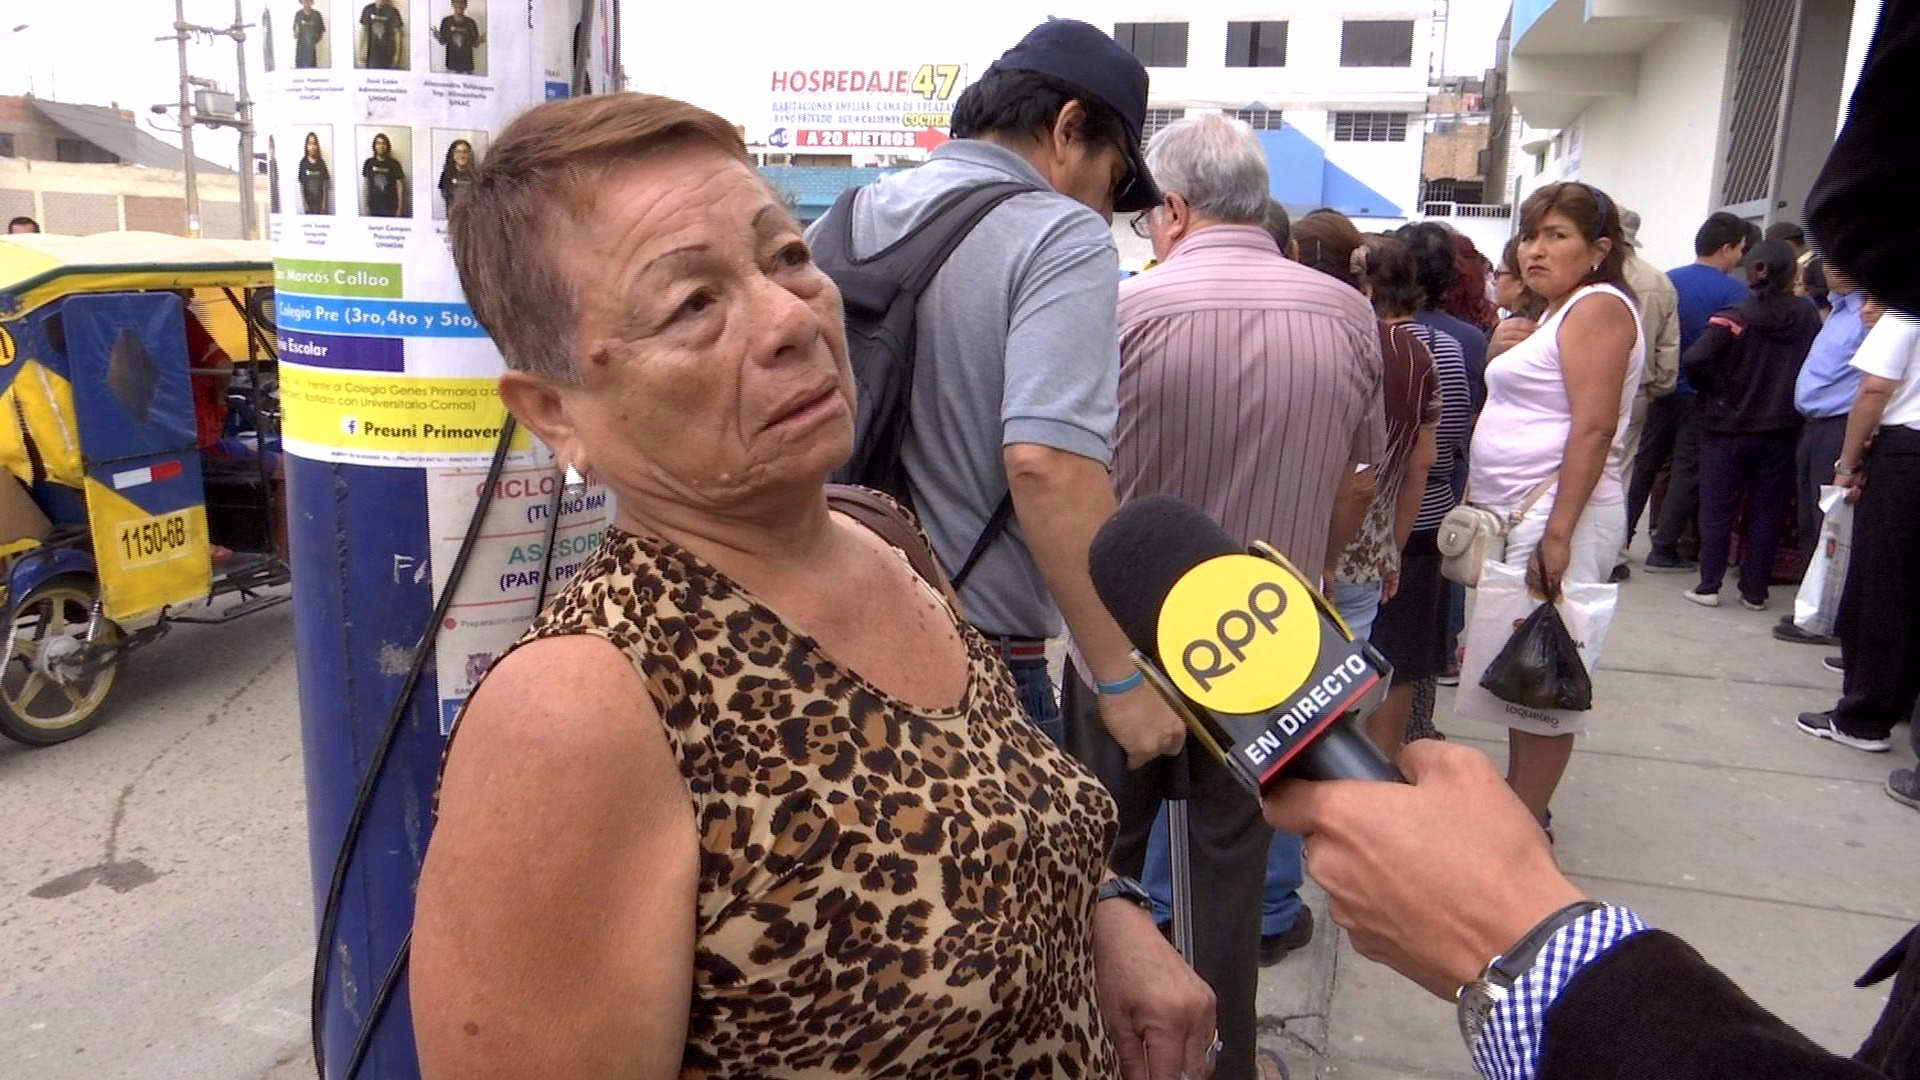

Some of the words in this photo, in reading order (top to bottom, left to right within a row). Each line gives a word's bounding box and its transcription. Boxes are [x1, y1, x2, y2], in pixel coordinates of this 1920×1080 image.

[771, 70, 908, 93] HOSPEDAJE
[911, 64, 961, 101] 47
[806, 130, 819, 146] A
[820, 130, 843, 146] 20
[847, 130, 916, 146] METROS
[286, 269, 329, 284] Marcos
[333, 269, 390, 287] Callao
[315, 305, 339, 322] Pre
[344, 309, 418, 328] (3ro,4to
[424, 313, 434, 329] y
[288, 337, 328, 358] Escolar
[344, 382, 386, 397] Colegio
[389, 384, 427, 397] Genes
[430, 386, 477, 398] Primaria
[364, 421, 417, 438] Preuni
[423, 423, 503, 439] Primaver
[527, 499, 584, 523] (TUNO
[121, 516, 186, 560] 1150-6B
[555, 563, 583, 583] PRI
[1243, 728, 1282, 766] EN
[1277, 652, 1368, 738] DIRECTO
